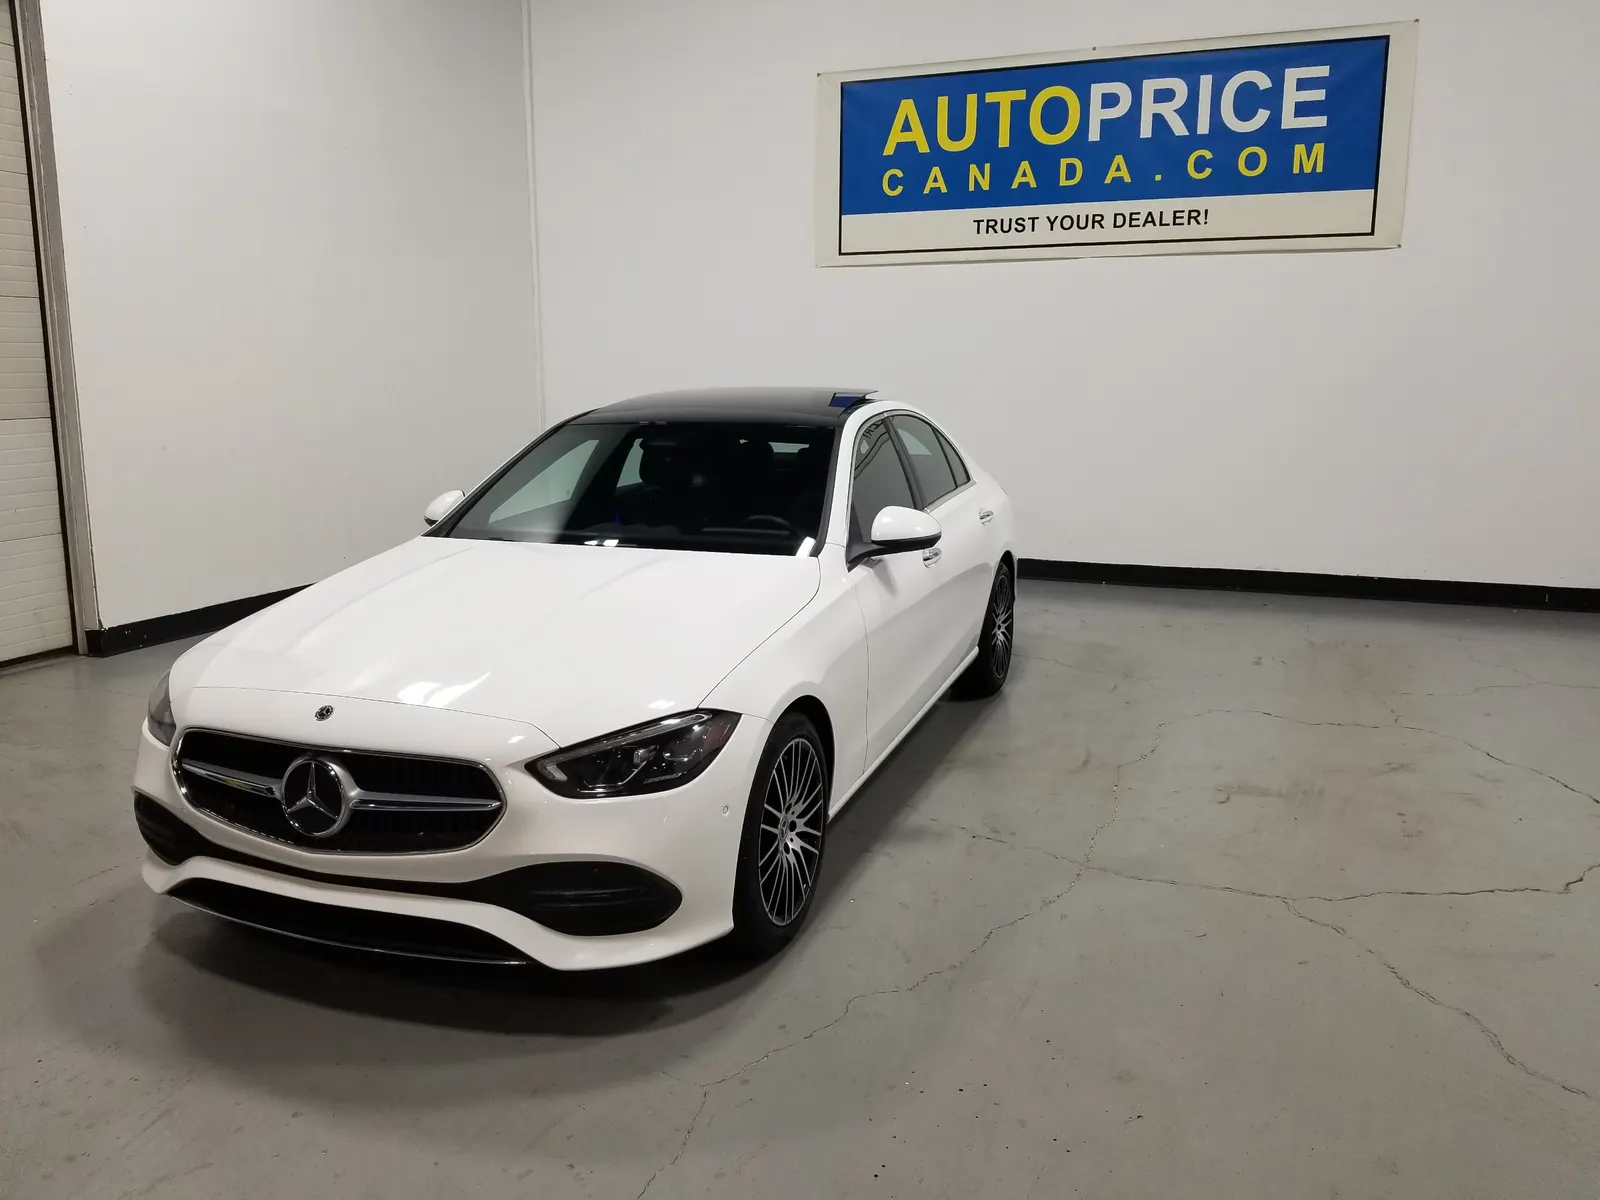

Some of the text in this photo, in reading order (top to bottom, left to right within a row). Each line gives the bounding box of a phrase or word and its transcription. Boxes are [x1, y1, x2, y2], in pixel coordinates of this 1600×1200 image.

[883, 65, 1330, 156] AUTOPRICE
[882, 143, 1325, 197] CANADA.COM
[973, 209, 1209, 235] TRUST YOUR DEALER!
